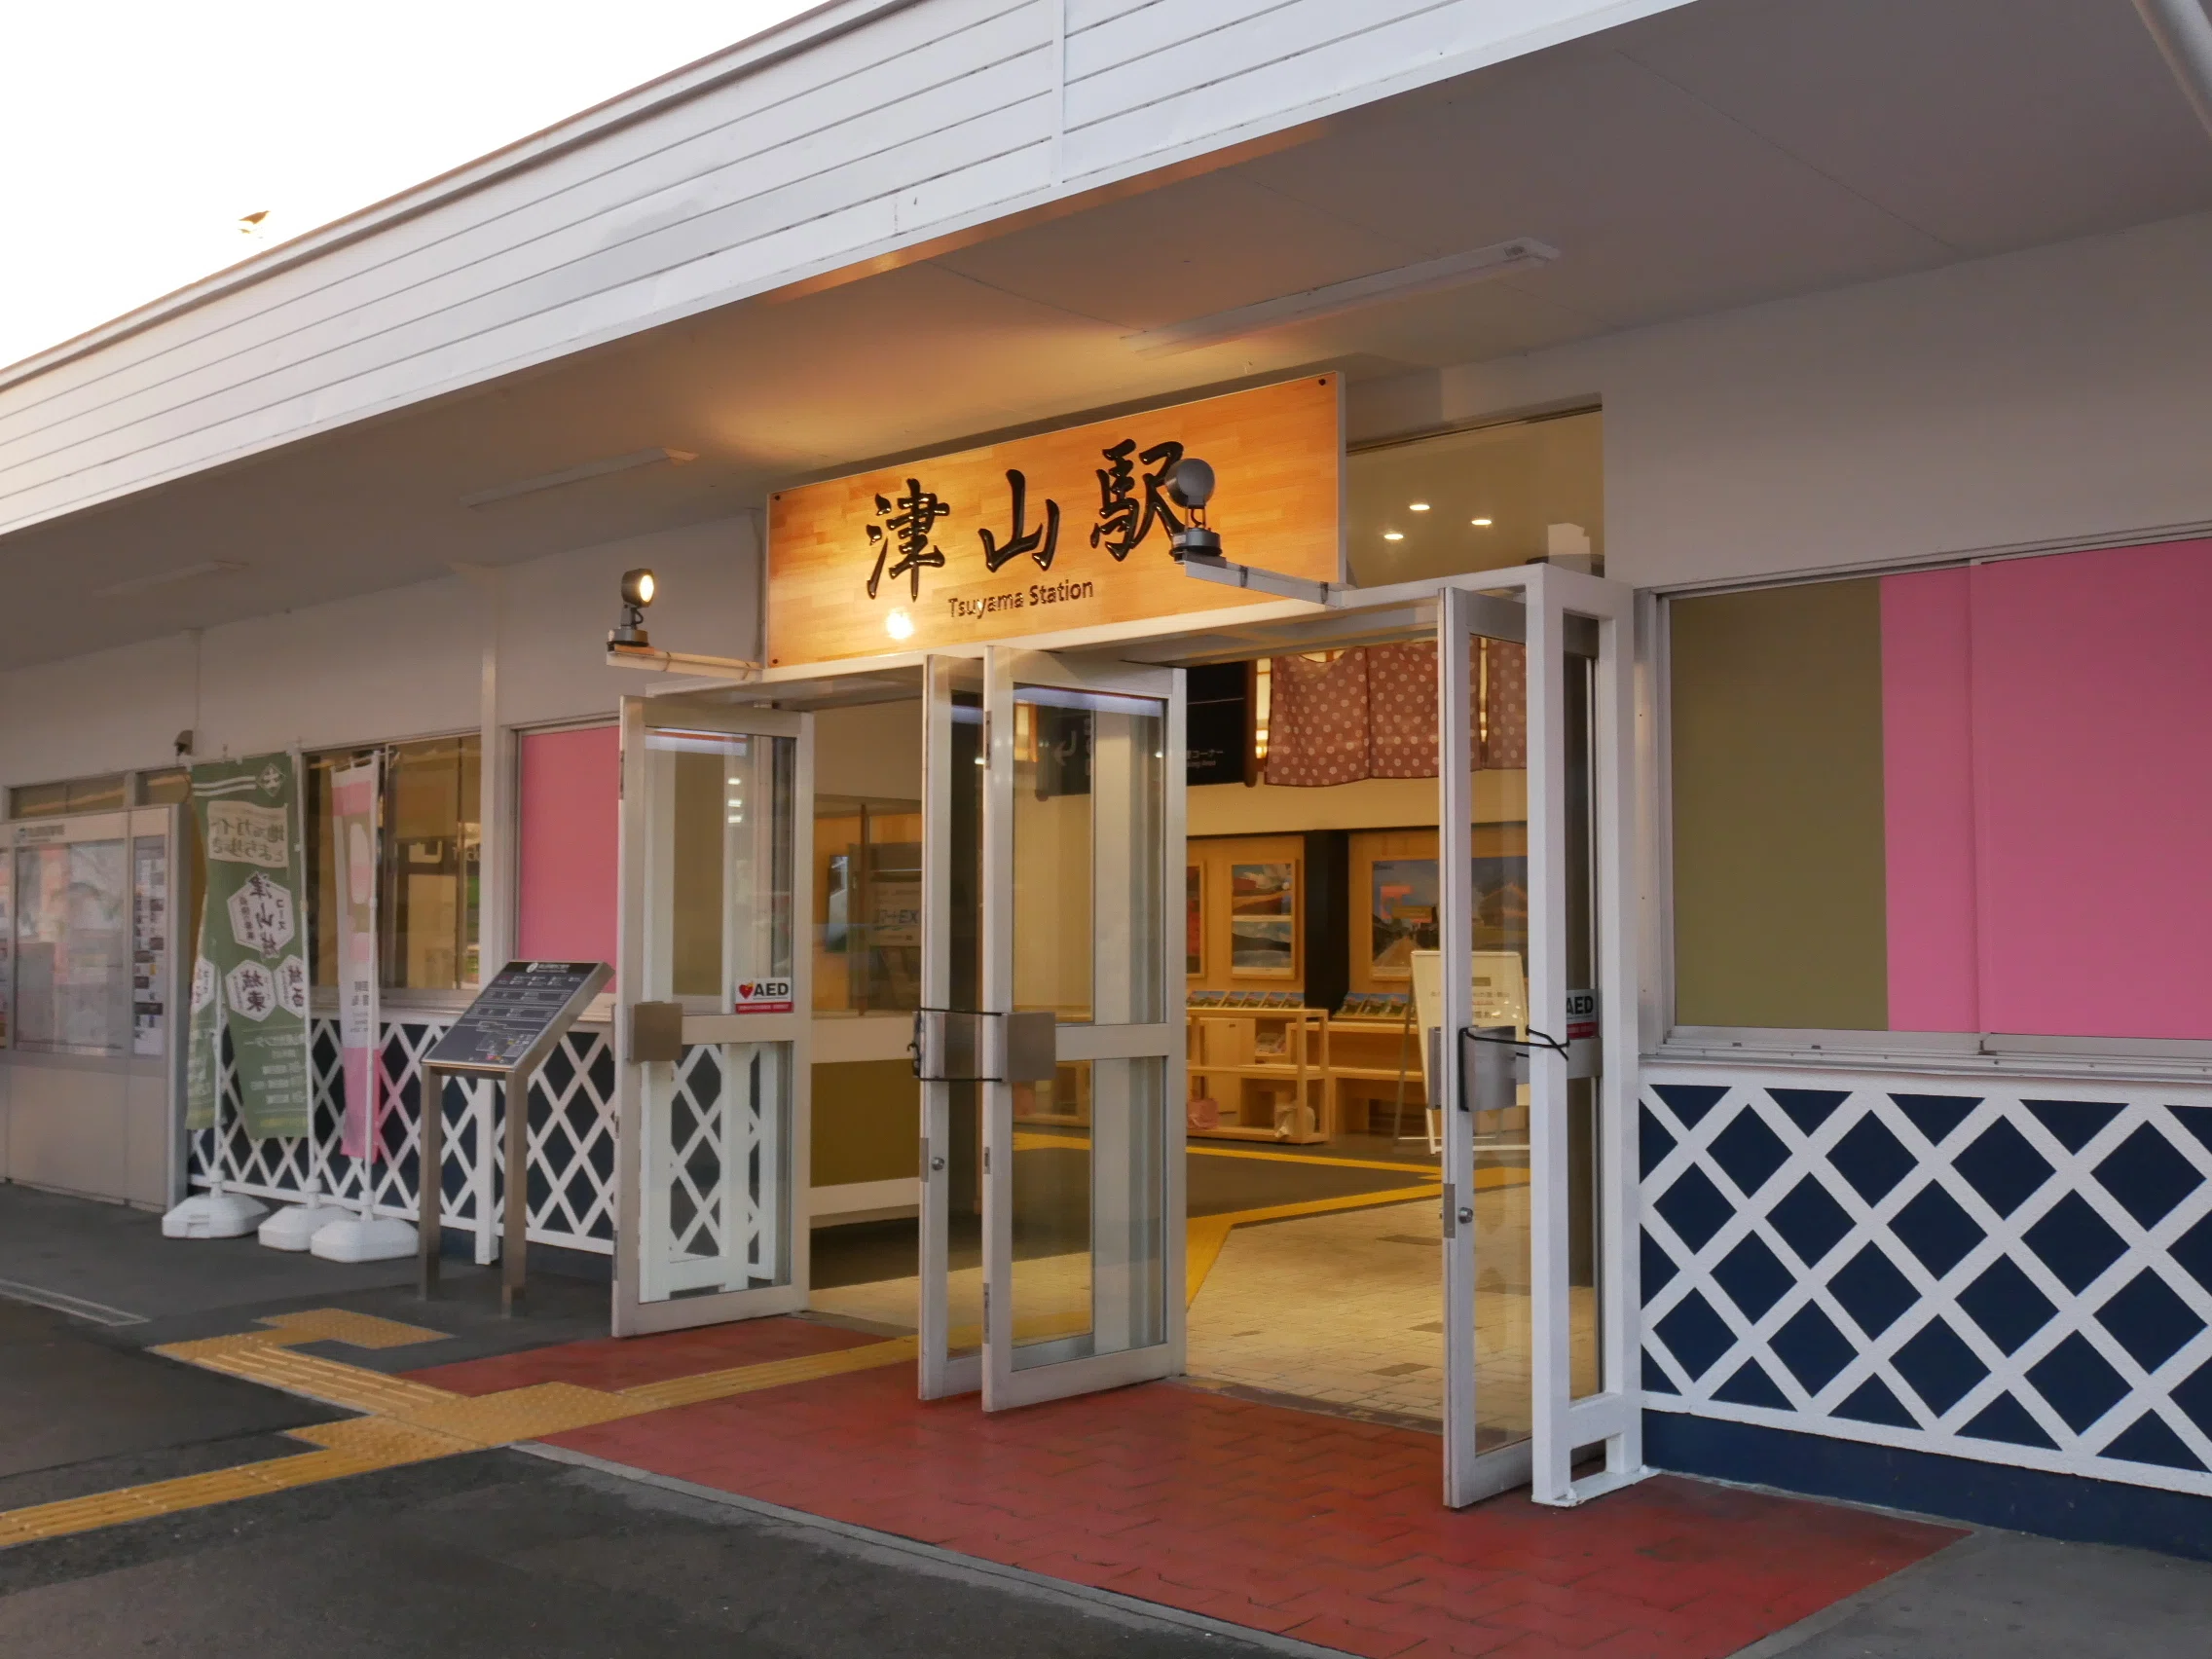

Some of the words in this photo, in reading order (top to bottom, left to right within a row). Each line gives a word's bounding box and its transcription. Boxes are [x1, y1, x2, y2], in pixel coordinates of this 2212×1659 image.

[866, 438, 1187, 604] 津山駅
[948, 591, 1024, 619] Tsuyama
[1029, 578, 1093, 607] Station
[755, 982, 789, 996] AED
[1567, 996, 1594, 1014] AED
